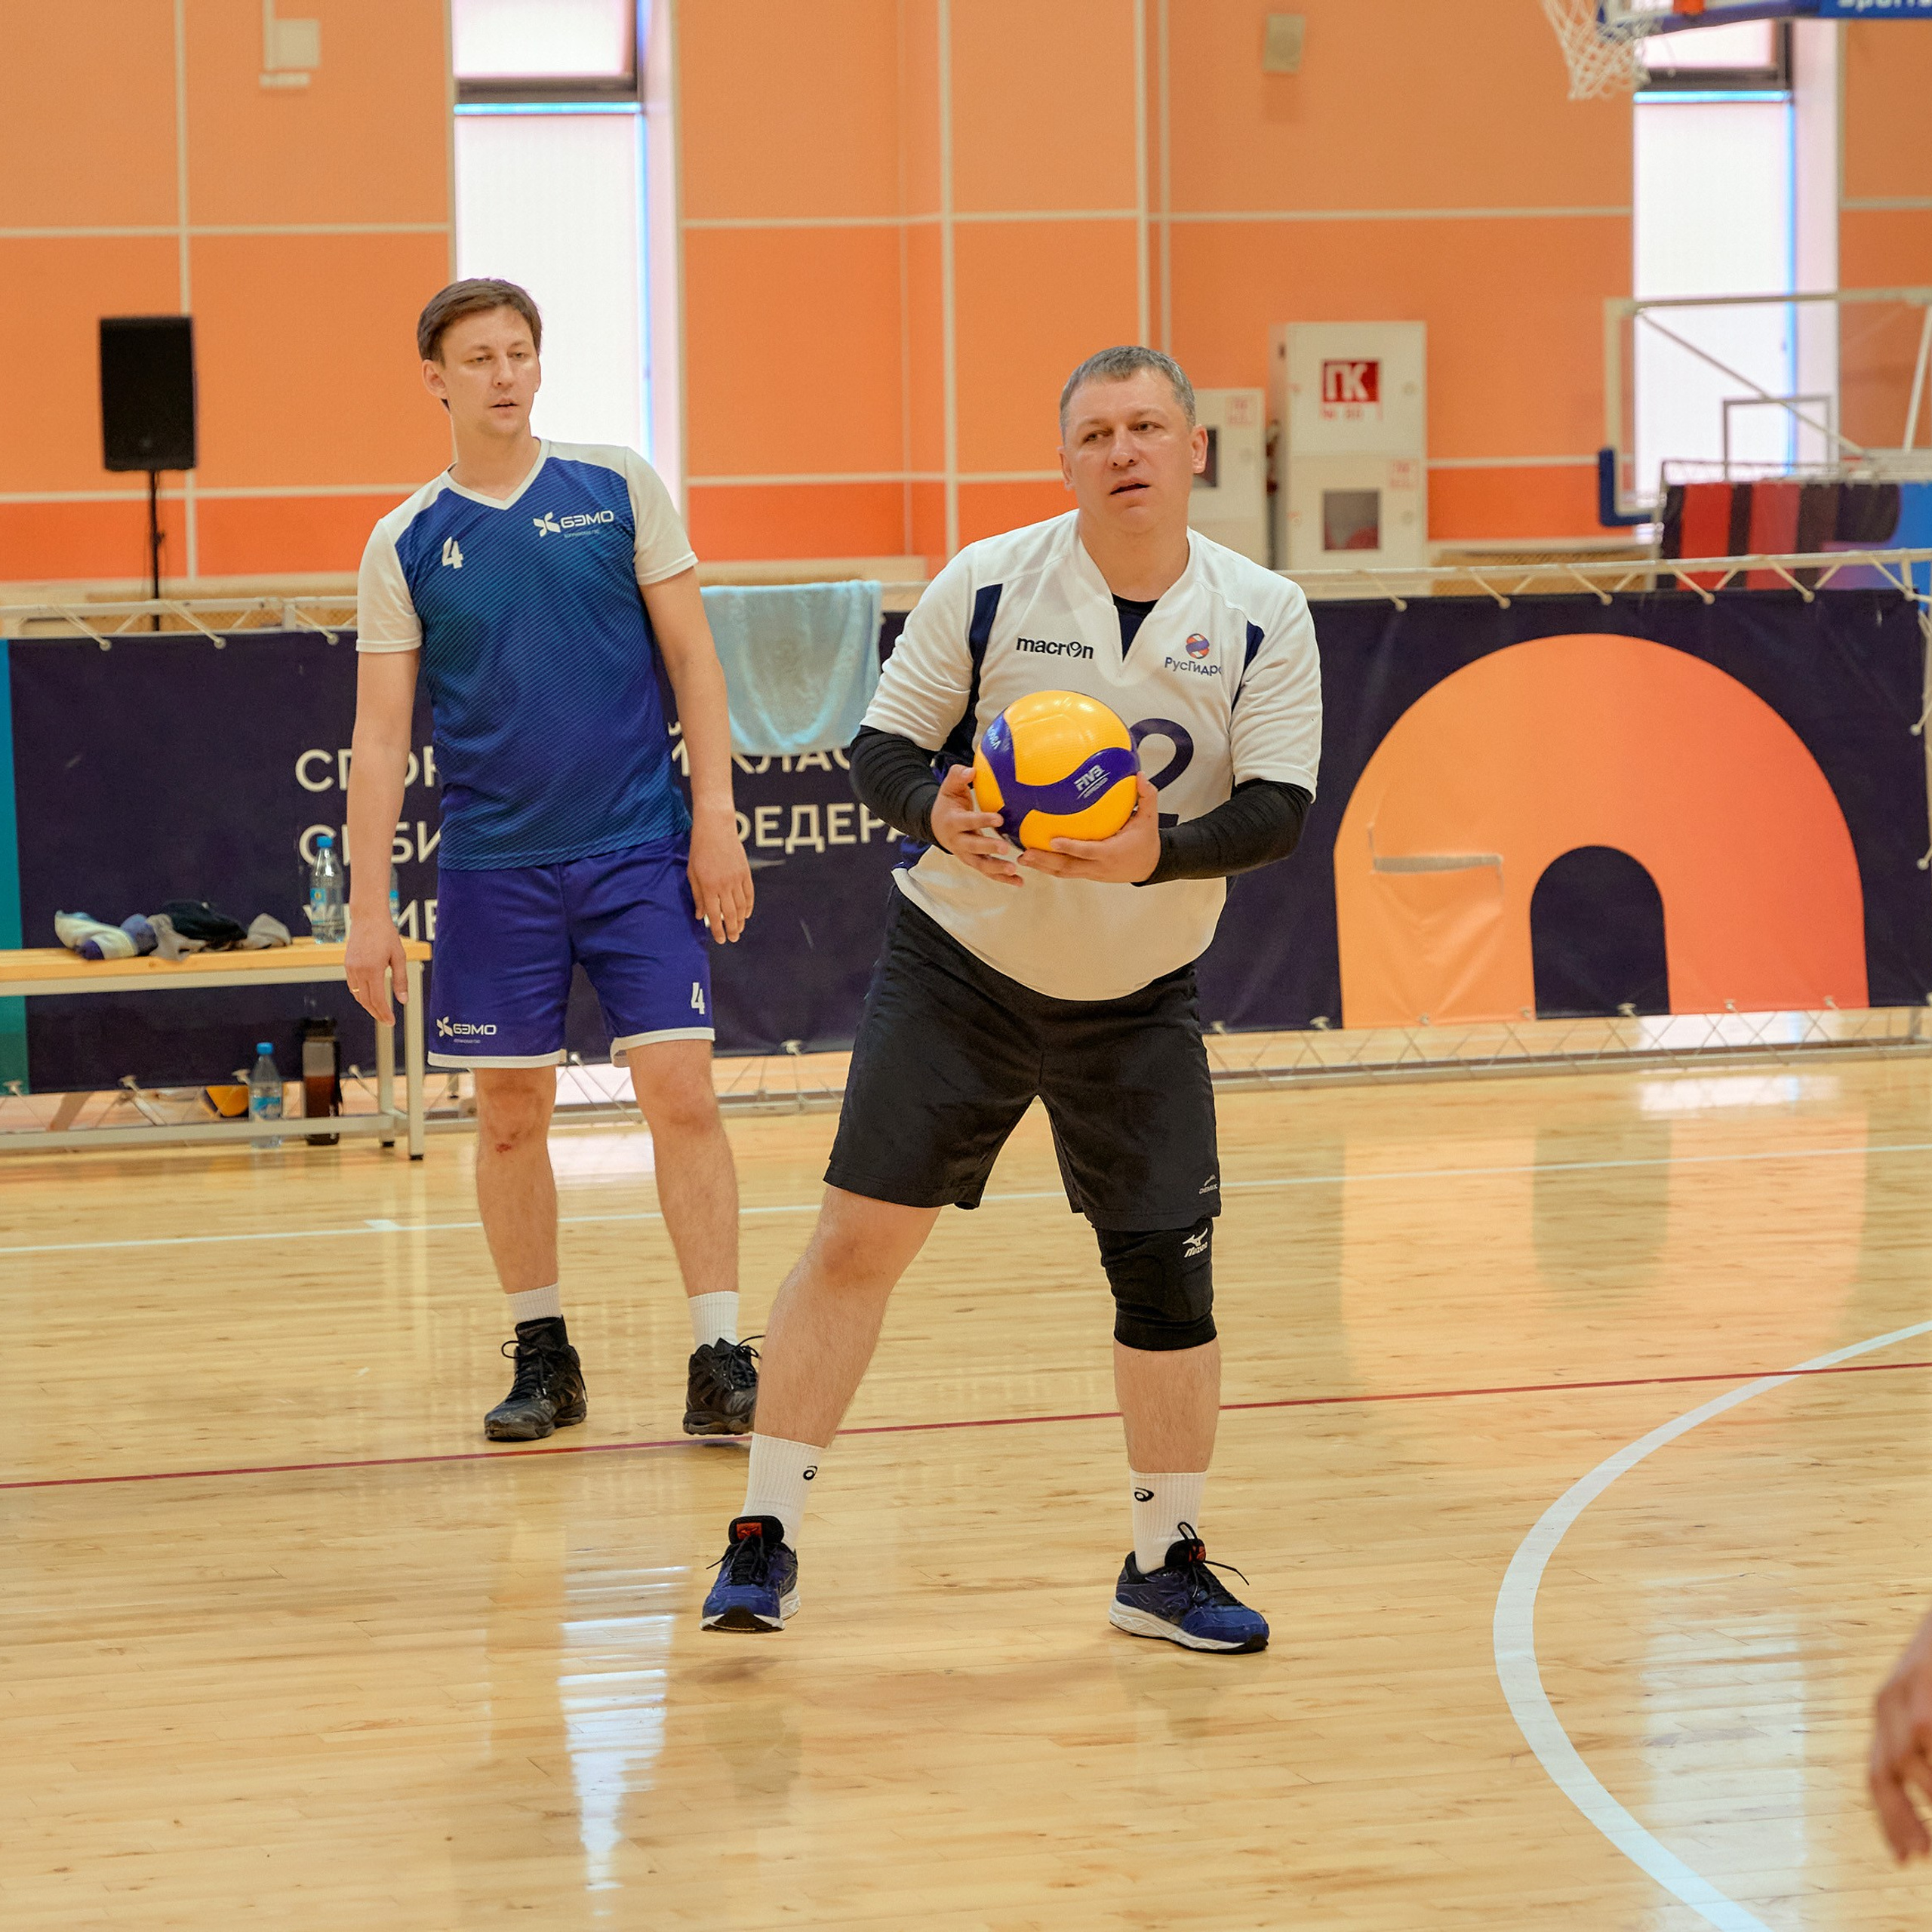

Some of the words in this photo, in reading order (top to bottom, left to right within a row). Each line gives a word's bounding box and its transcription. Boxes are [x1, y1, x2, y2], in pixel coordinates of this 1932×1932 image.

[1325, 364, 1369, 400] ПК
[441, 536, 463, 569] 4
[1016, 637, 1094, 660] macron
[1073, 764, 1106, 791] FIVB
[734, 802, 907, 855] ЕДЕР
[691, 982, 705, 1014] 4
